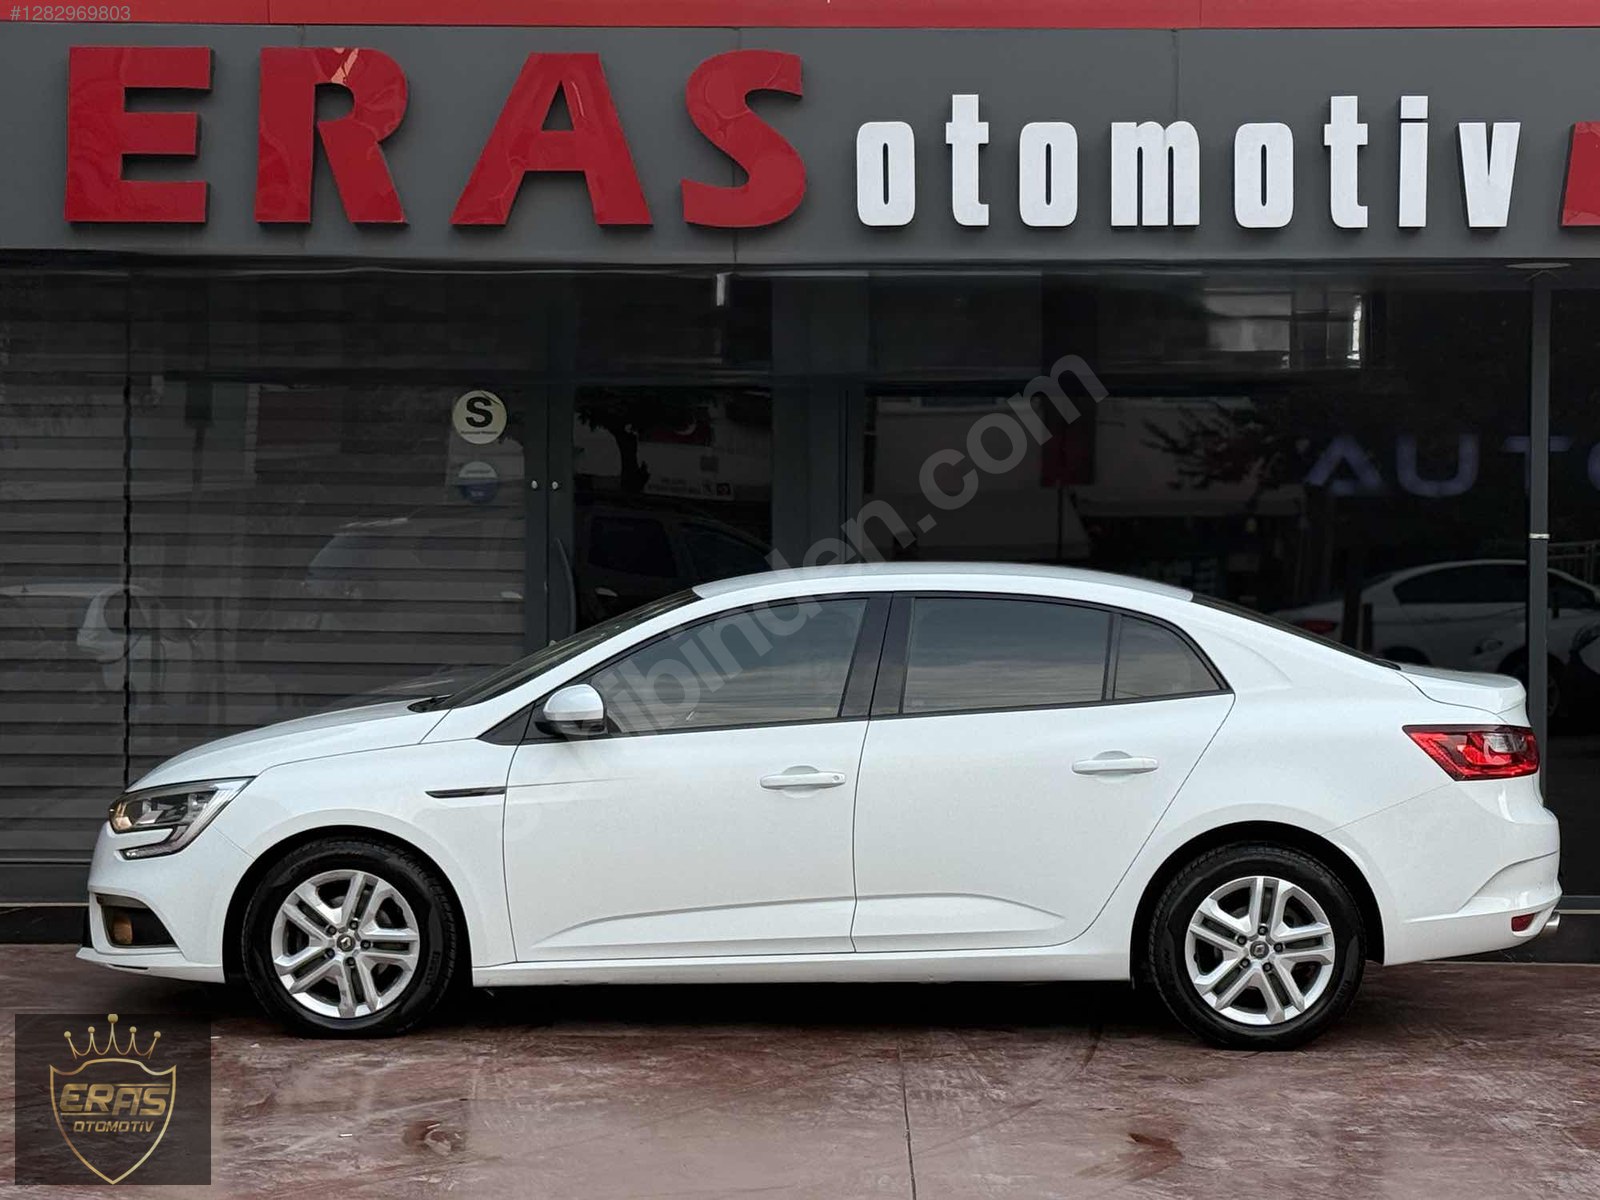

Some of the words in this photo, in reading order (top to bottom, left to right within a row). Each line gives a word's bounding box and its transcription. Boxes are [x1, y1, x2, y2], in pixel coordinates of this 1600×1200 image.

[65, 46, 806, 229] ERAS
[856, 94, 1521, 229] otomotiv
[465, 396, 493, 428] S
